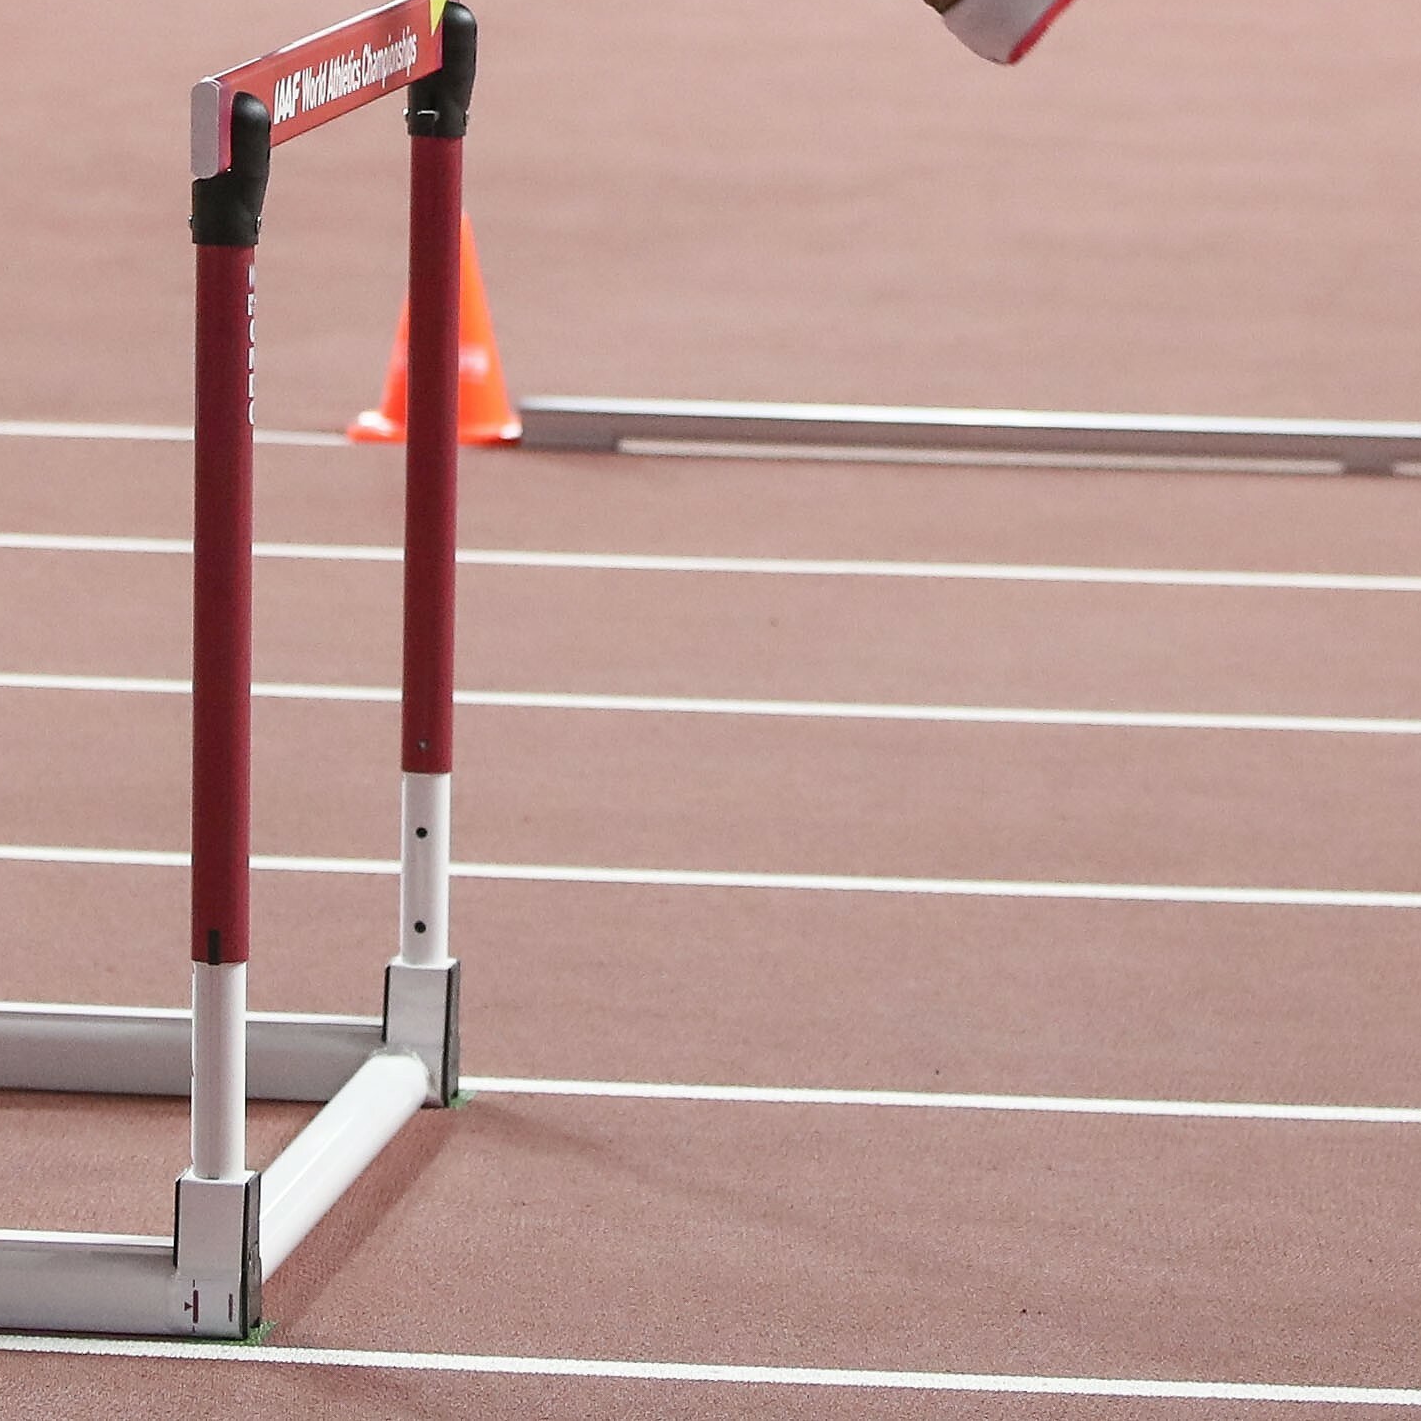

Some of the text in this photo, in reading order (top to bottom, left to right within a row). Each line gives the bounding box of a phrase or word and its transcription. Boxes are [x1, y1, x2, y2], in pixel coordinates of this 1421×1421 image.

[273, 26, 417, 125] IAAF World Athletics Championships
